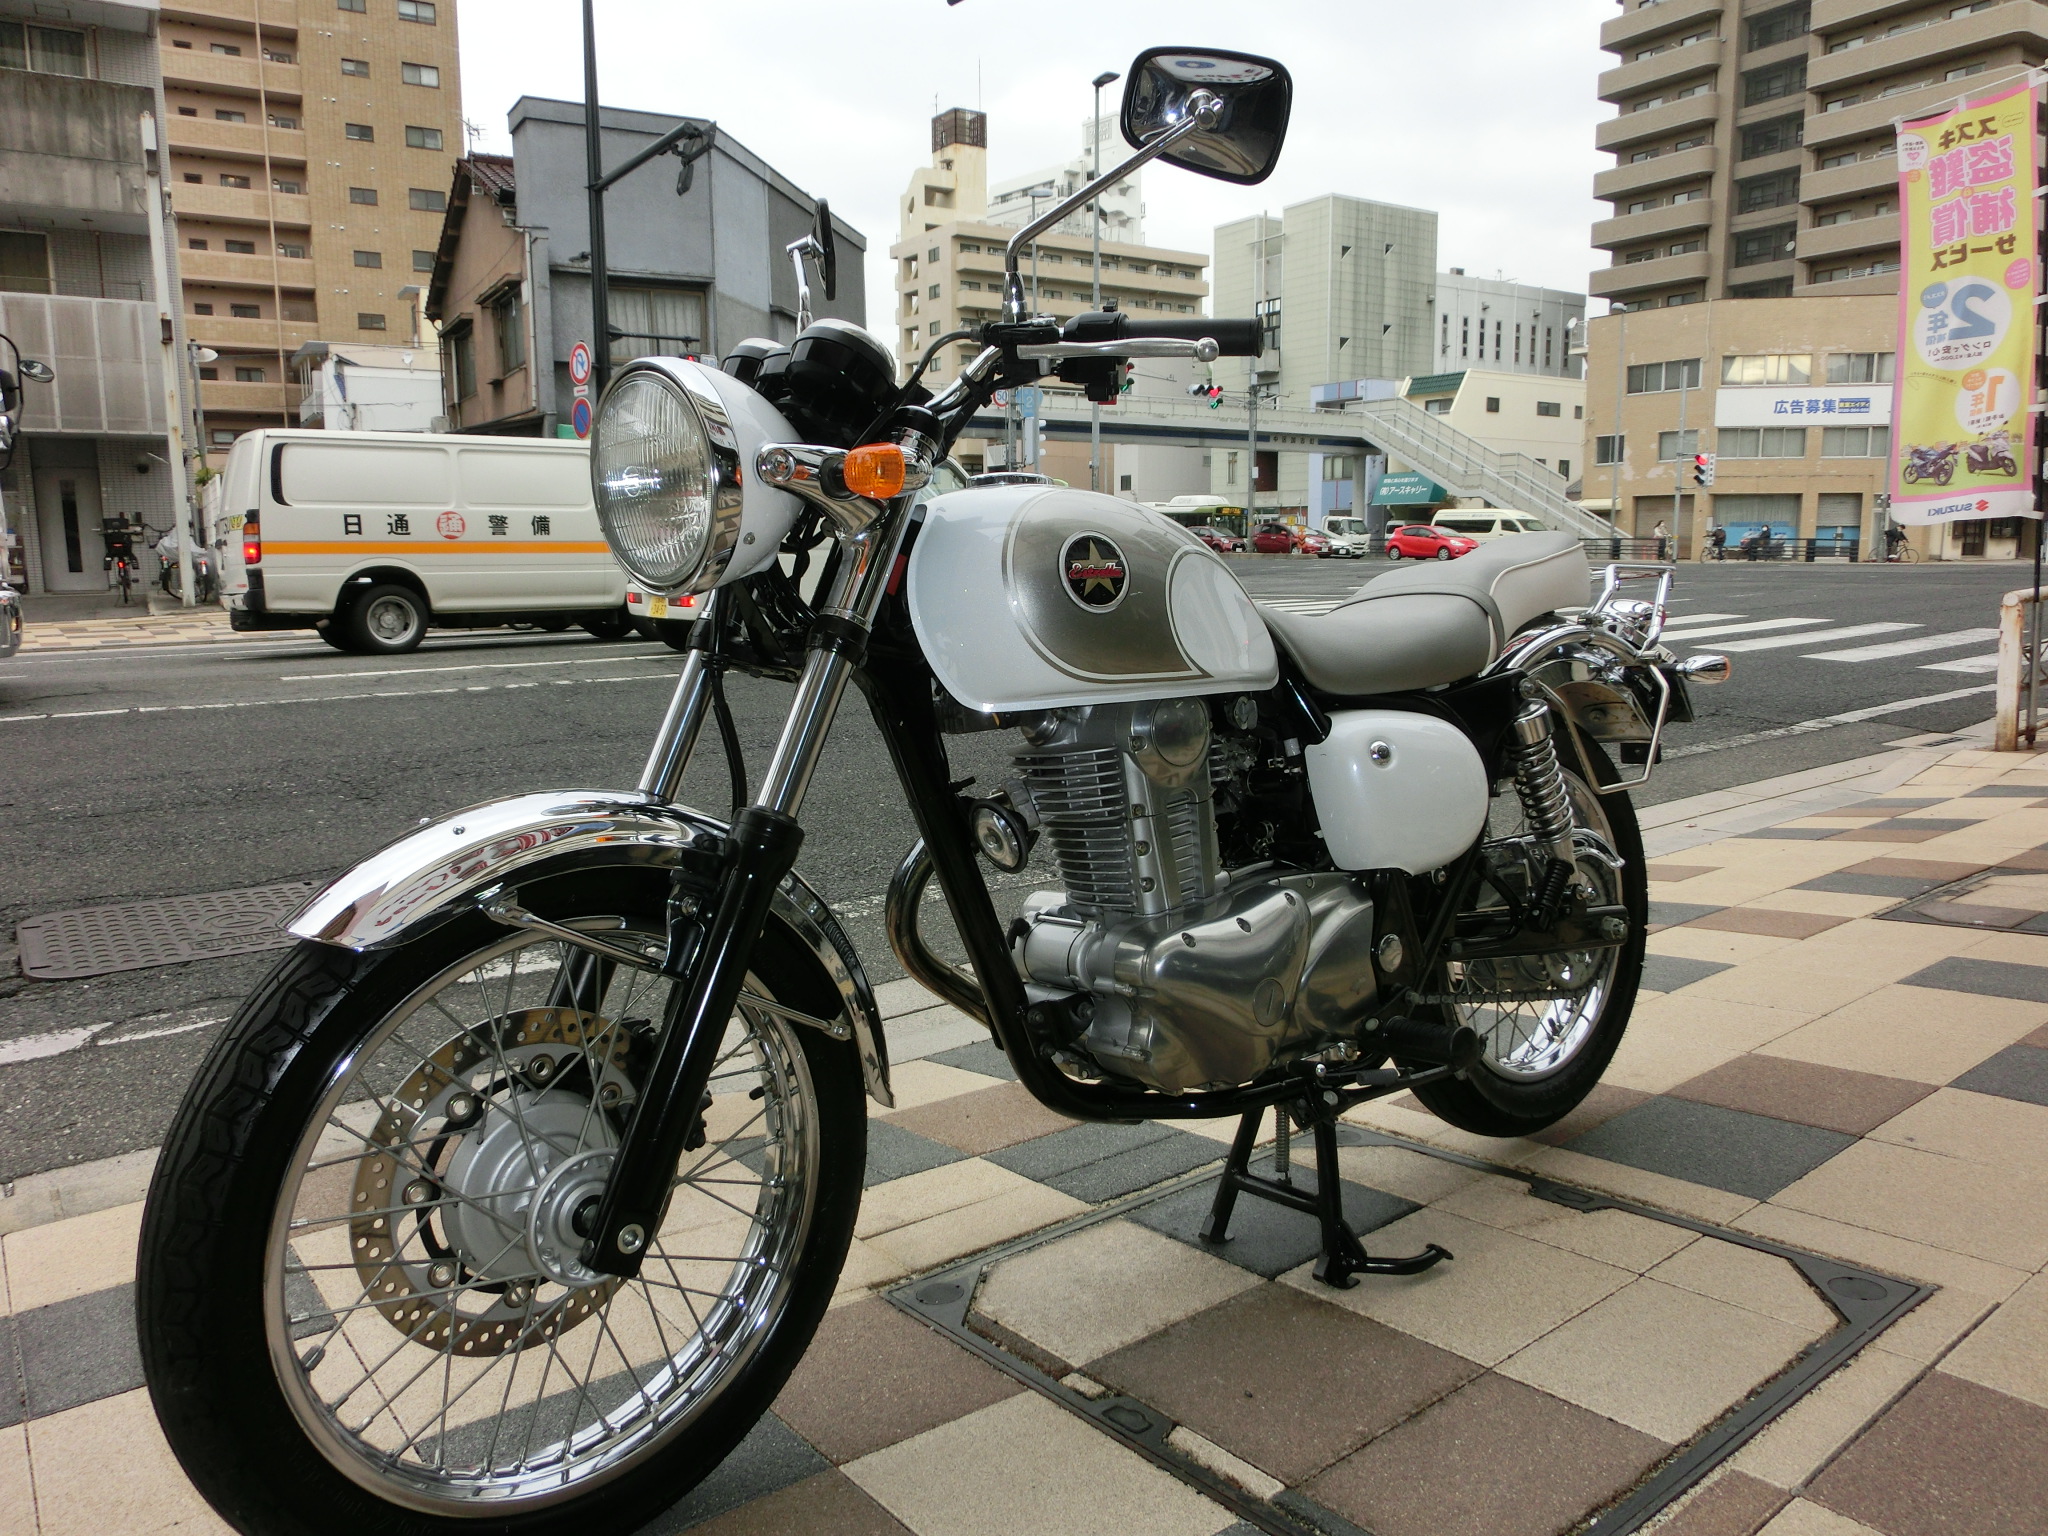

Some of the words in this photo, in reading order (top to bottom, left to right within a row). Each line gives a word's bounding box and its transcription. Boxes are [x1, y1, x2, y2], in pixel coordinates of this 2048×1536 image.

[1026, 396, 1033, 408] 2
[1773, 398, 1837, 415] 広告募集
